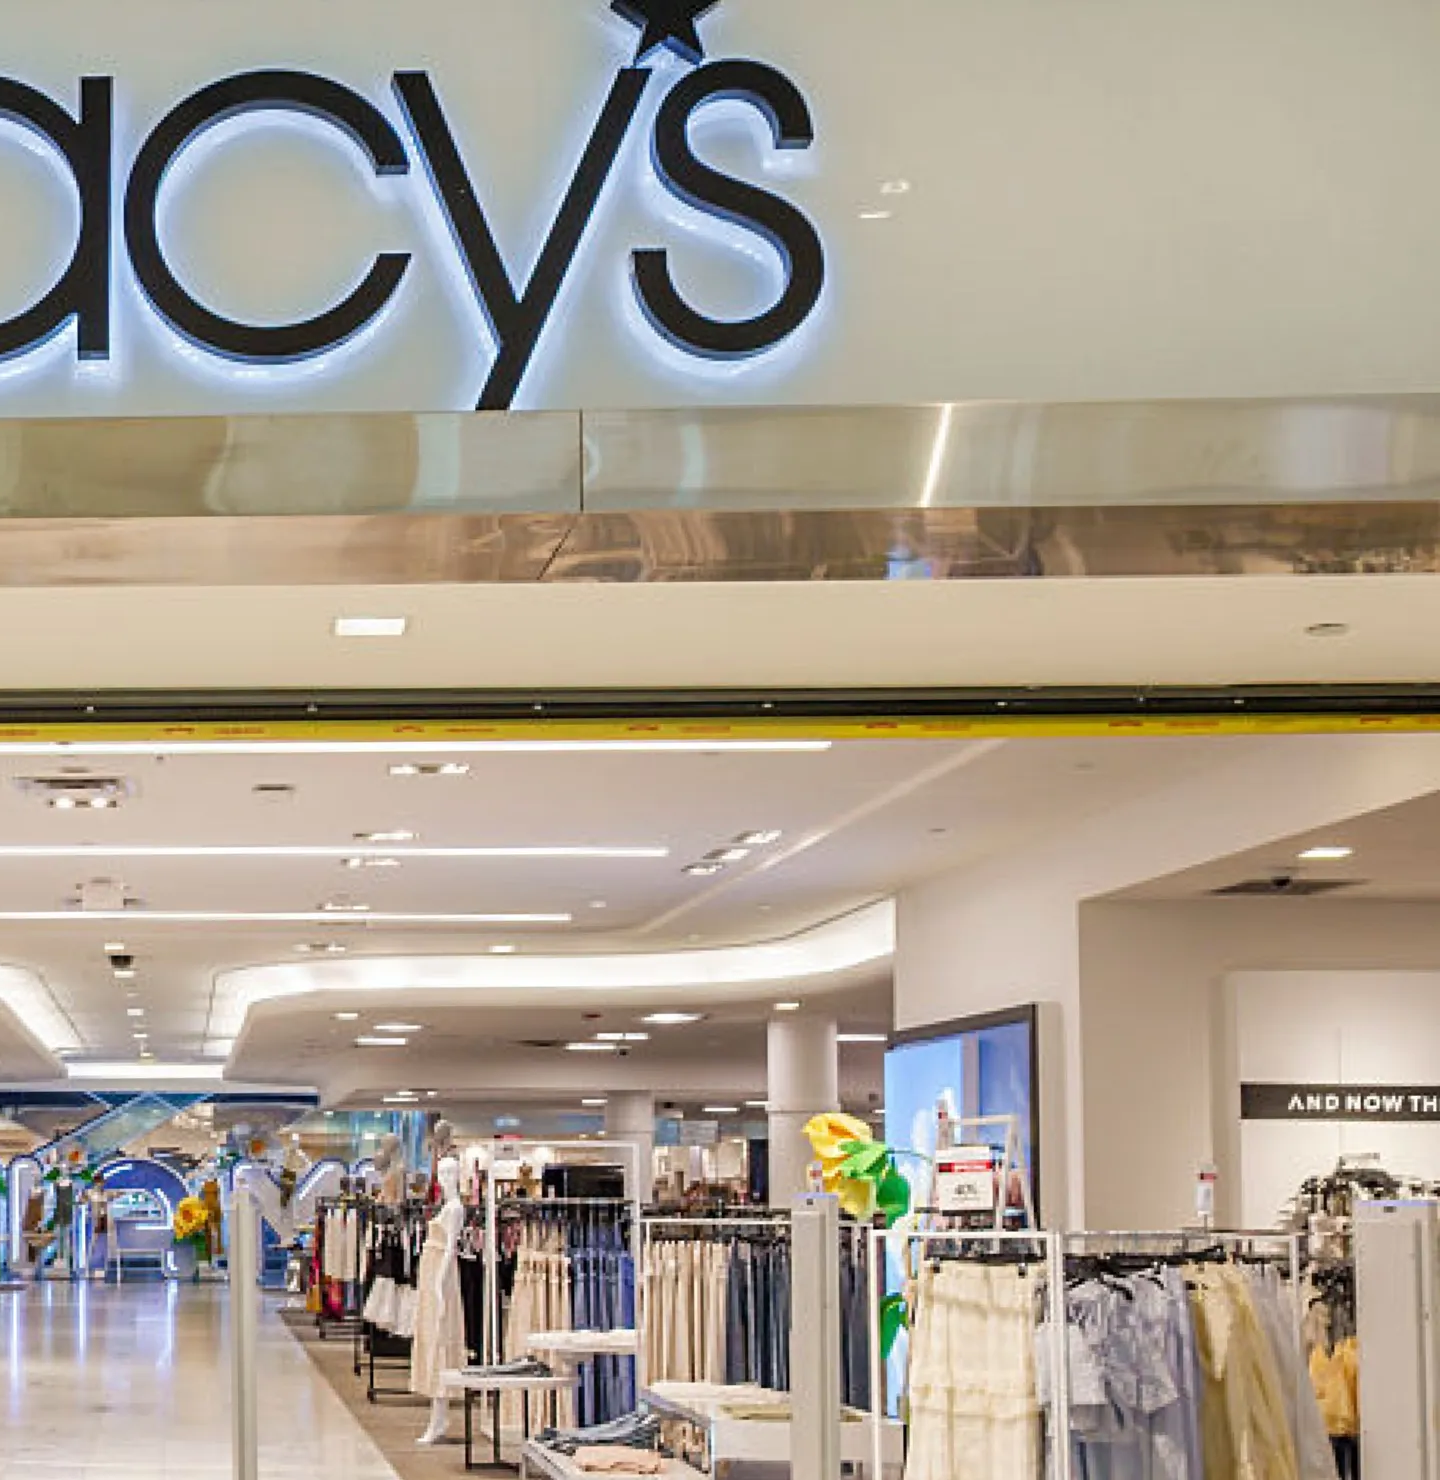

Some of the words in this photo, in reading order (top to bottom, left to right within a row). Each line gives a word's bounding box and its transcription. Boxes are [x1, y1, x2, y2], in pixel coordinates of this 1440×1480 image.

[1287, 1093, 1339, 1112] AND
[1345, 1093, 1405, 1112] NOW
[1407, 1095, 1440, 1112] TH
